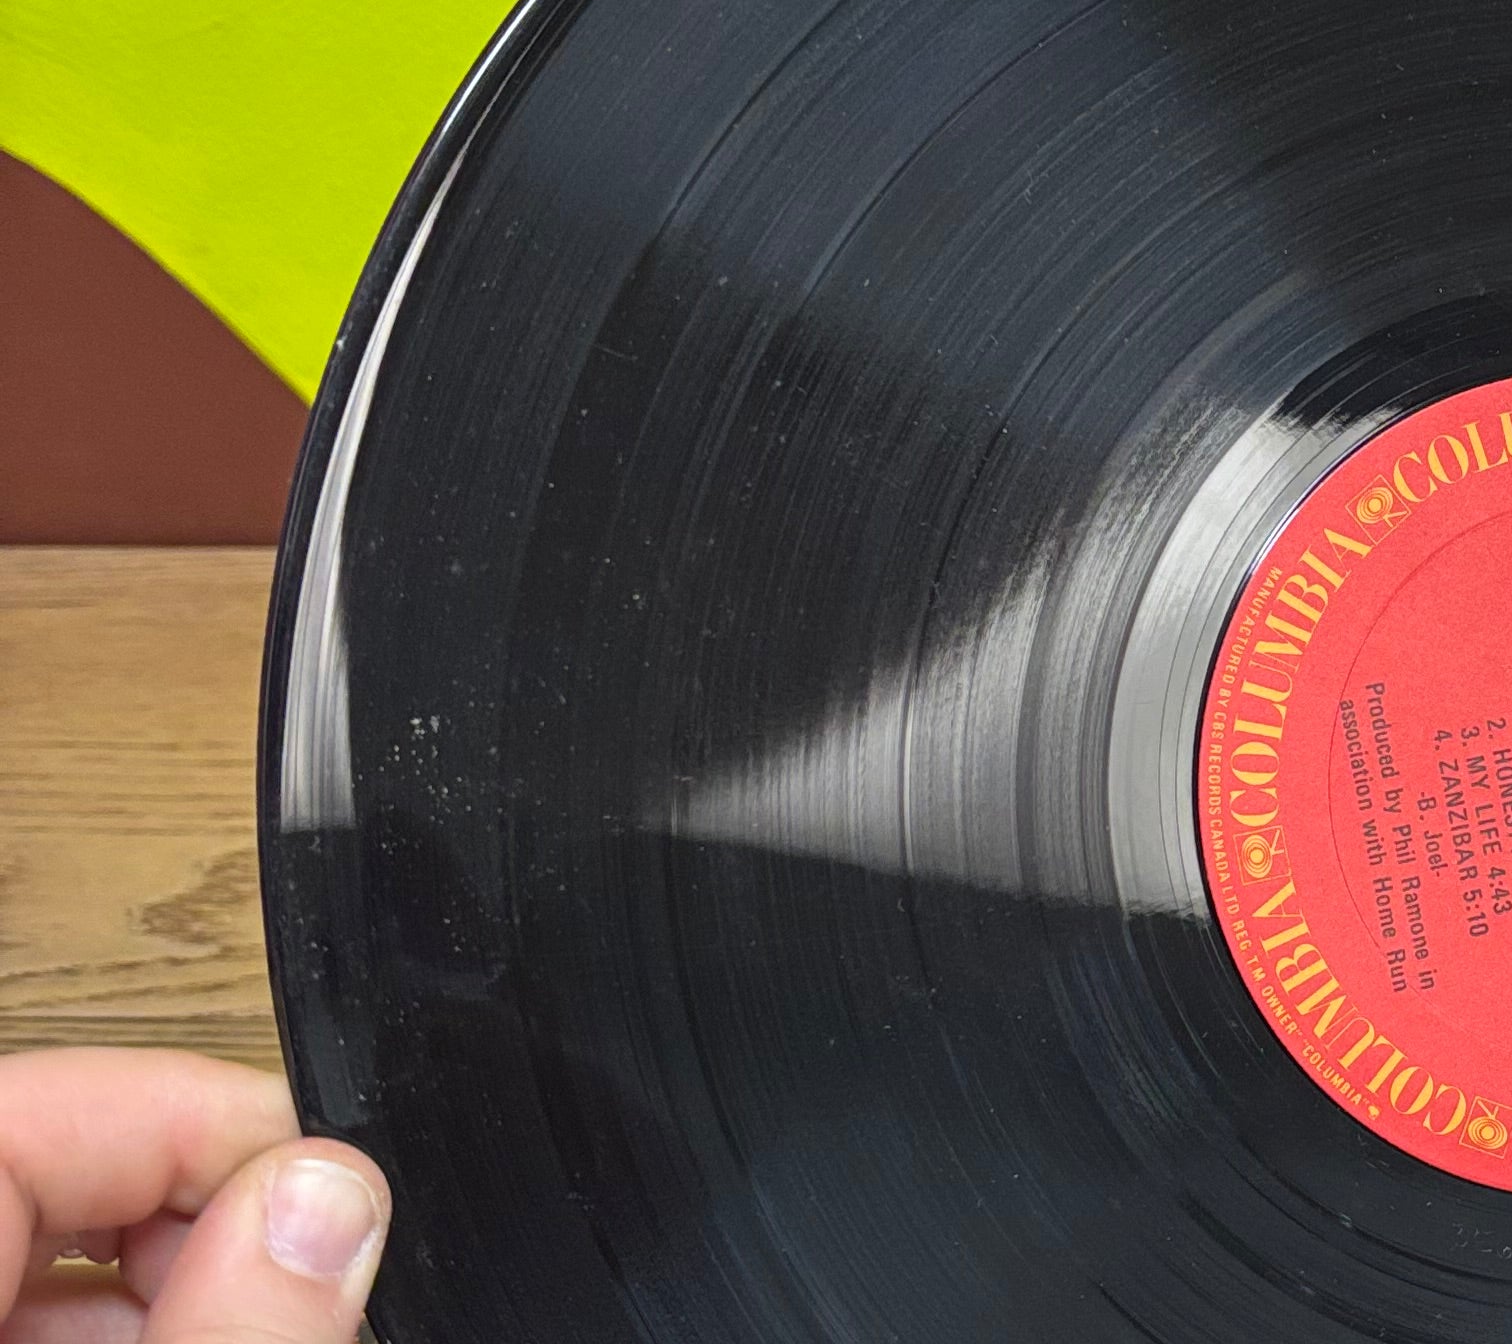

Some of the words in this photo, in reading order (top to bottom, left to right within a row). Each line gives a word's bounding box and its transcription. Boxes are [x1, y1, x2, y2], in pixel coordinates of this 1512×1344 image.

[1222, 566, 1283, 684] MANUFACTURED
[1230, 528, 1372, 827] COLUMBIA
[1365, 682, 1400, 779] Produced
[1434, 730, 1452, 751] 4.
[1461, 726, 1480, 747] 3.
[1487, 718, 1506, 739] 2.
[1340, 699, 1373, 811] association
[1466, 756, 1490, 790] MY
[1383, 788, 1404, 814] by
[1439, 759, 1479, 881] ZANZIBAR
[1362, 820, 1387, 866] with
[1393, 824, 1416, 864] Phil
[1475, 804, 1503, 855] LIFE
[1373, 876, 1397, 939] Home
[1463, 889, 1489, 937] 5:10
[1488, 866, 1512, 915] 4:43
[1401, 876, 1429, 961] Ramone
[1387, 949, 1407, 993] Run
[1419, 969, 1438, 990] in
[1252, 877, 1468, 1135] COLUMBIA
